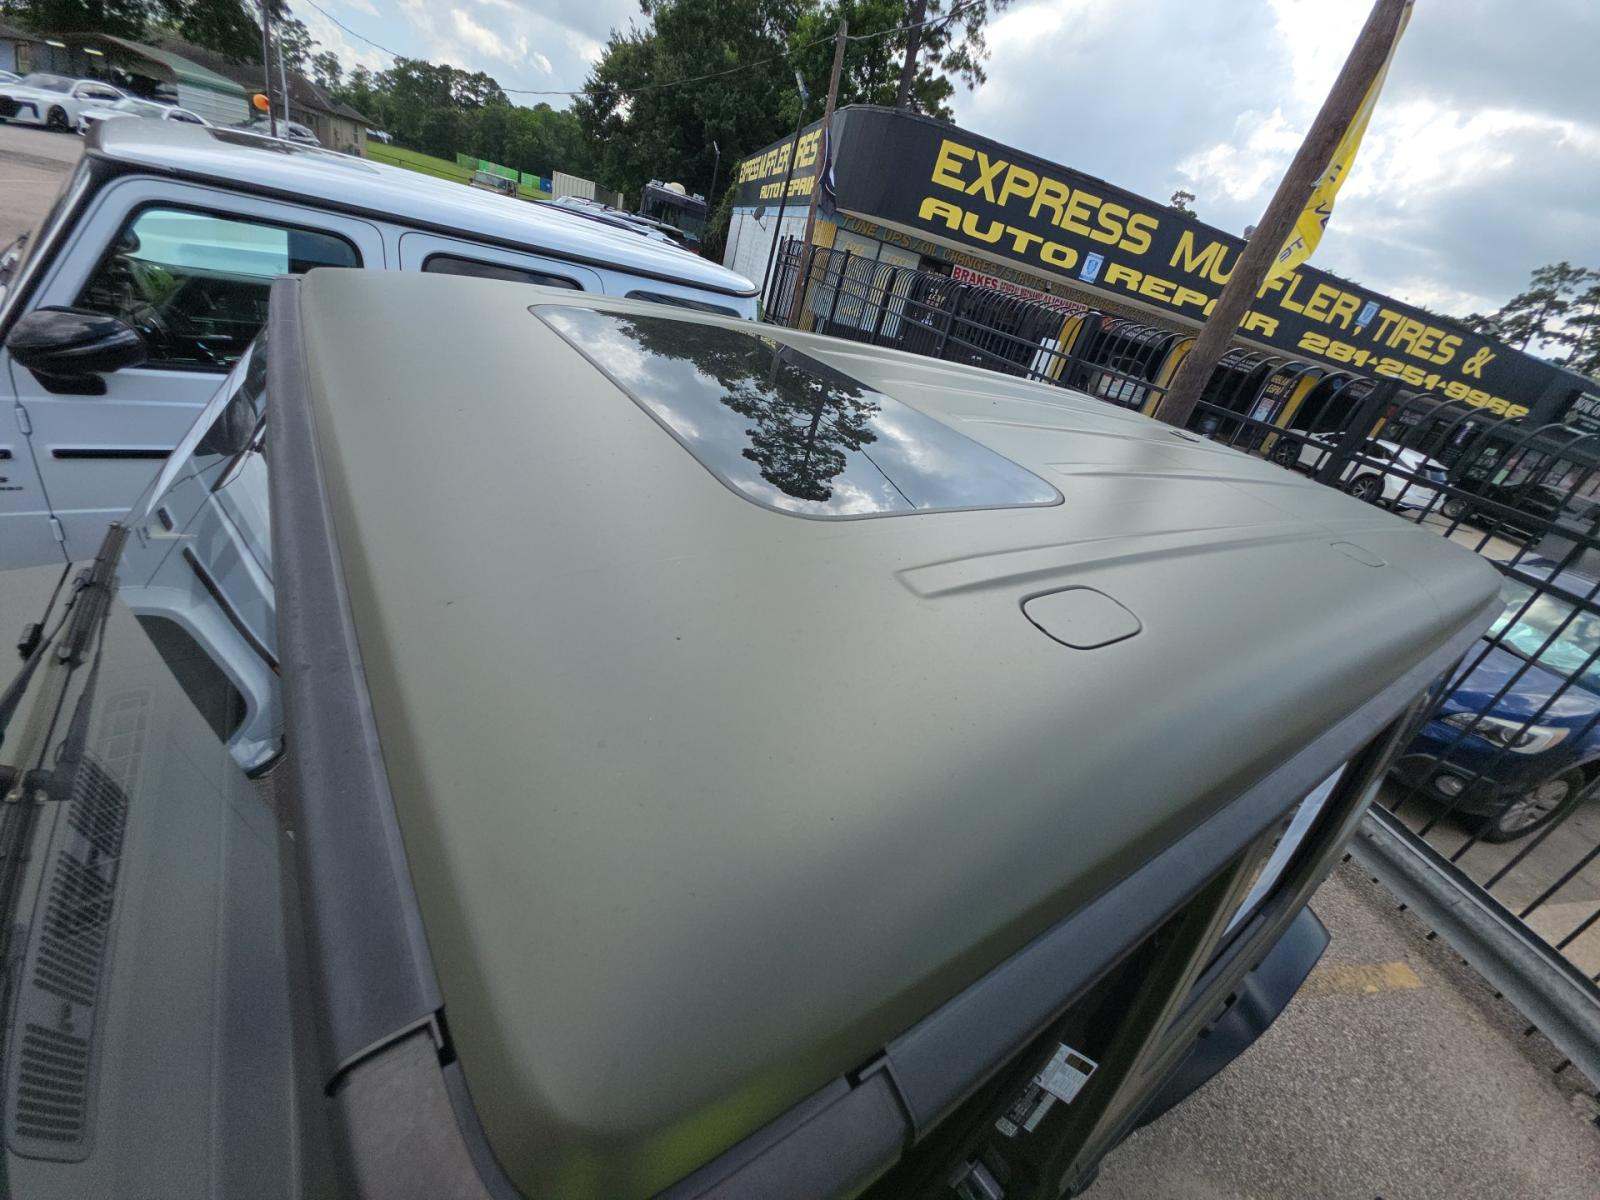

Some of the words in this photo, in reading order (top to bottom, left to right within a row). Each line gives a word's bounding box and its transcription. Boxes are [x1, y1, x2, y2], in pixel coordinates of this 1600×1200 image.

[841, 214, 880, 238] TUNE
[883, 230, 913, 250] UPS
[918, 197, 1079, 270] AUTO
[1103, 262, 1280, 338] REPIR
[931, 139, 1159, 255] EXPRESS
[1168, 230, 1363, 336] MUFLER,
[1372, 308, 1464, 366] TIRES
[1461, 346, 1497, 379] &
[952, 266, 999, 290] BRAKES
